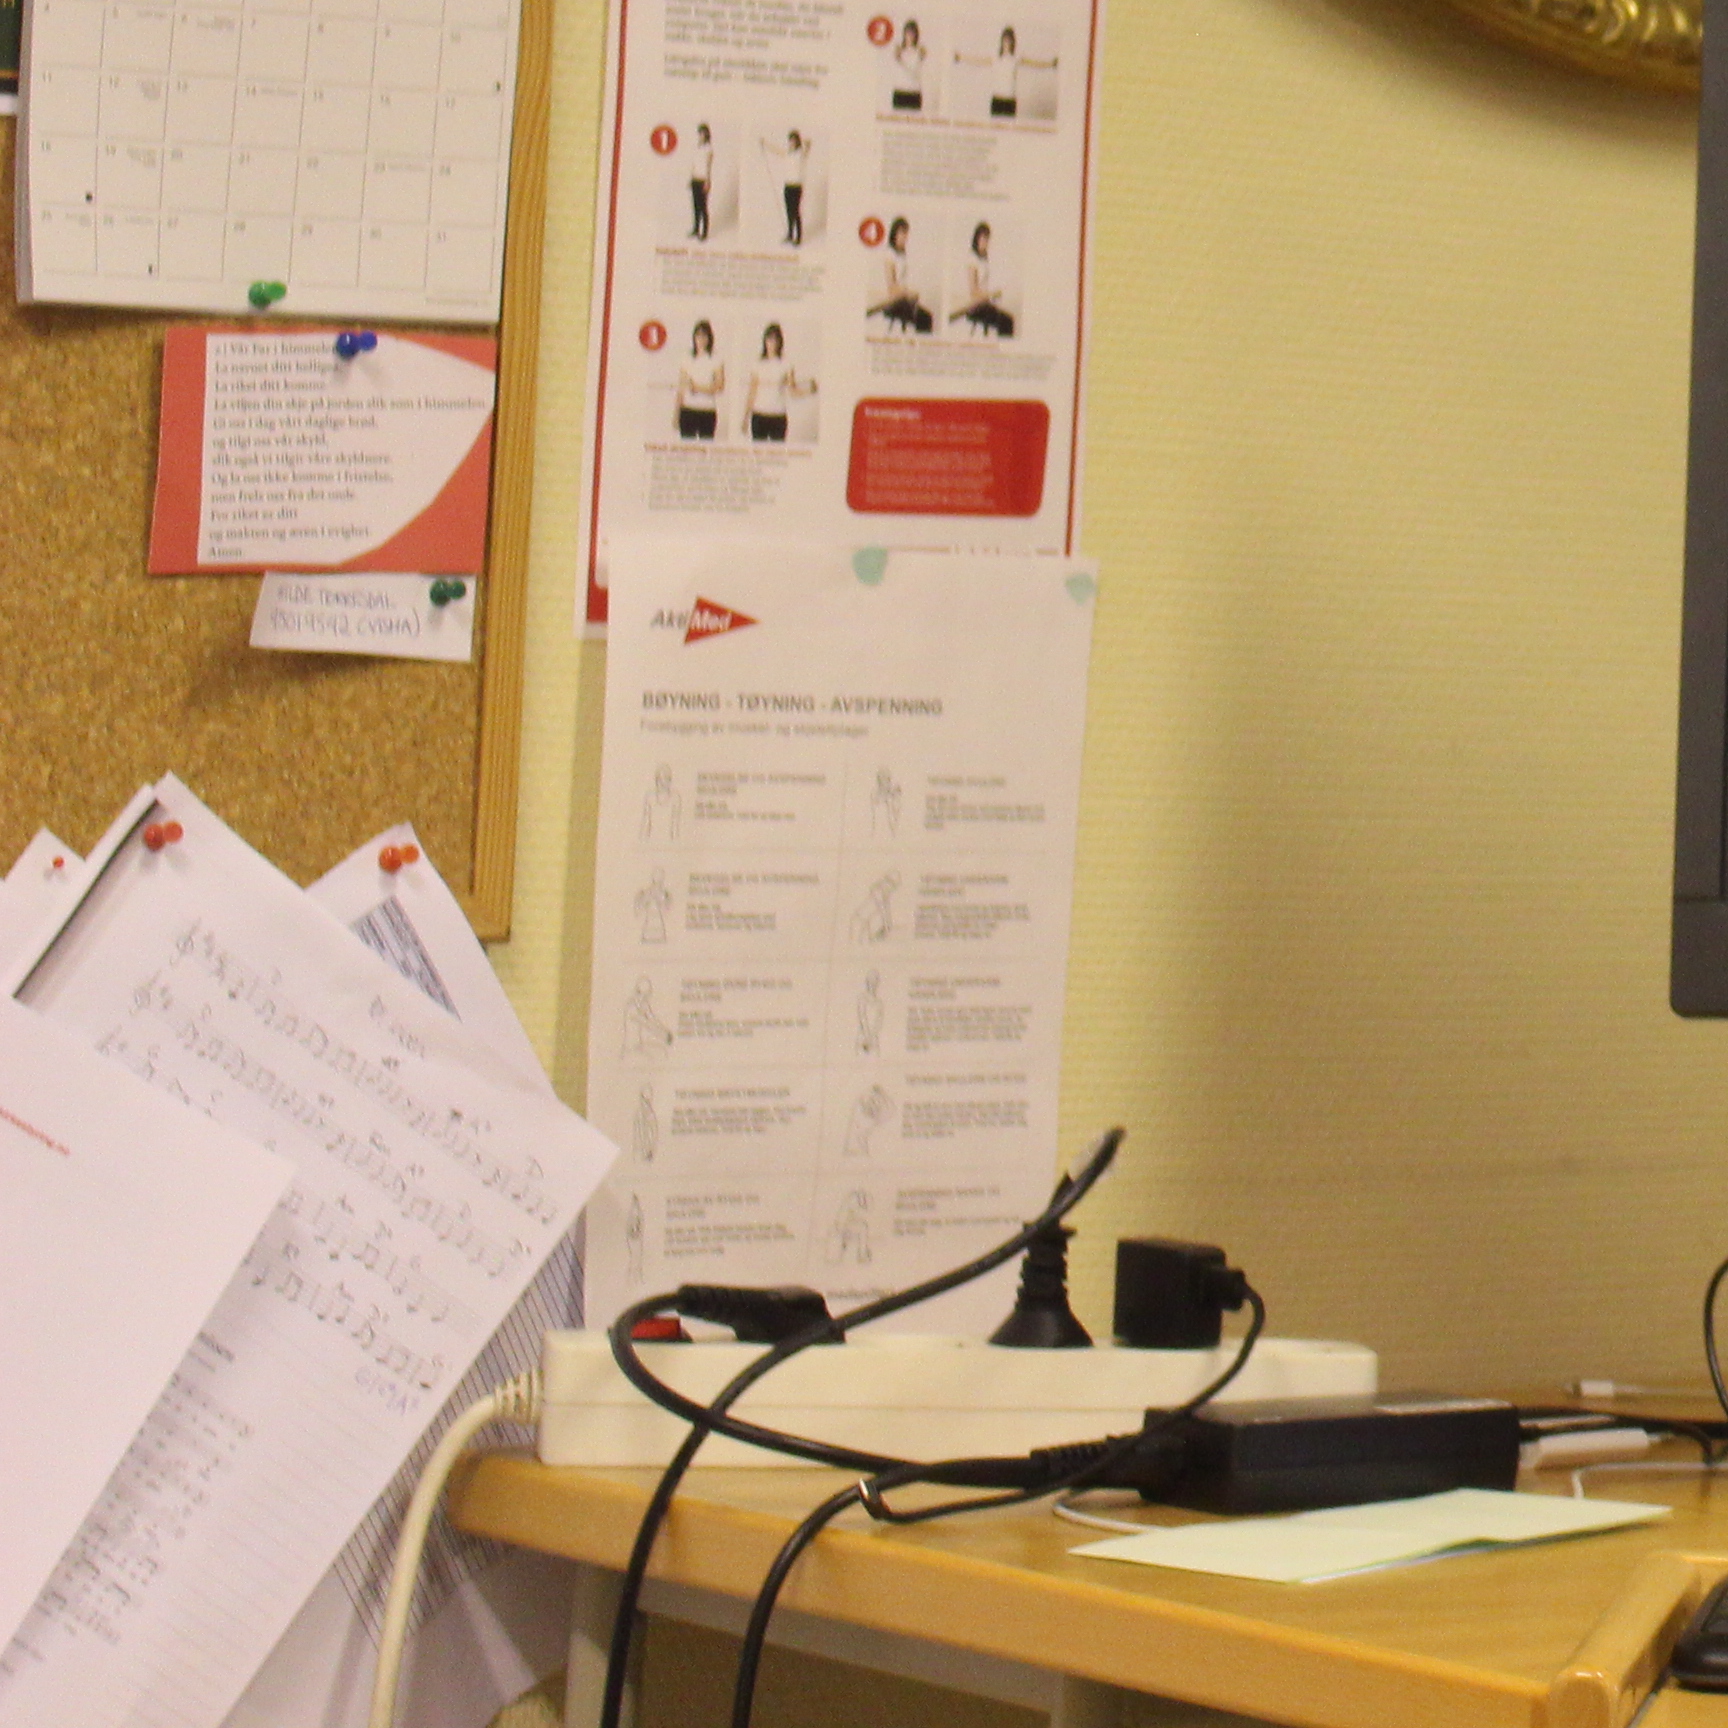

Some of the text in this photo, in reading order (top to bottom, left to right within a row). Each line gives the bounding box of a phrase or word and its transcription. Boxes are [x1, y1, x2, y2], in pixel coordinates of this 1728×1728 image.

[642, 690, 721, 712] BØYNING
[736, 692, 815, 714] TØYNING
[830, 695, 943, 717] AVSPENNING
